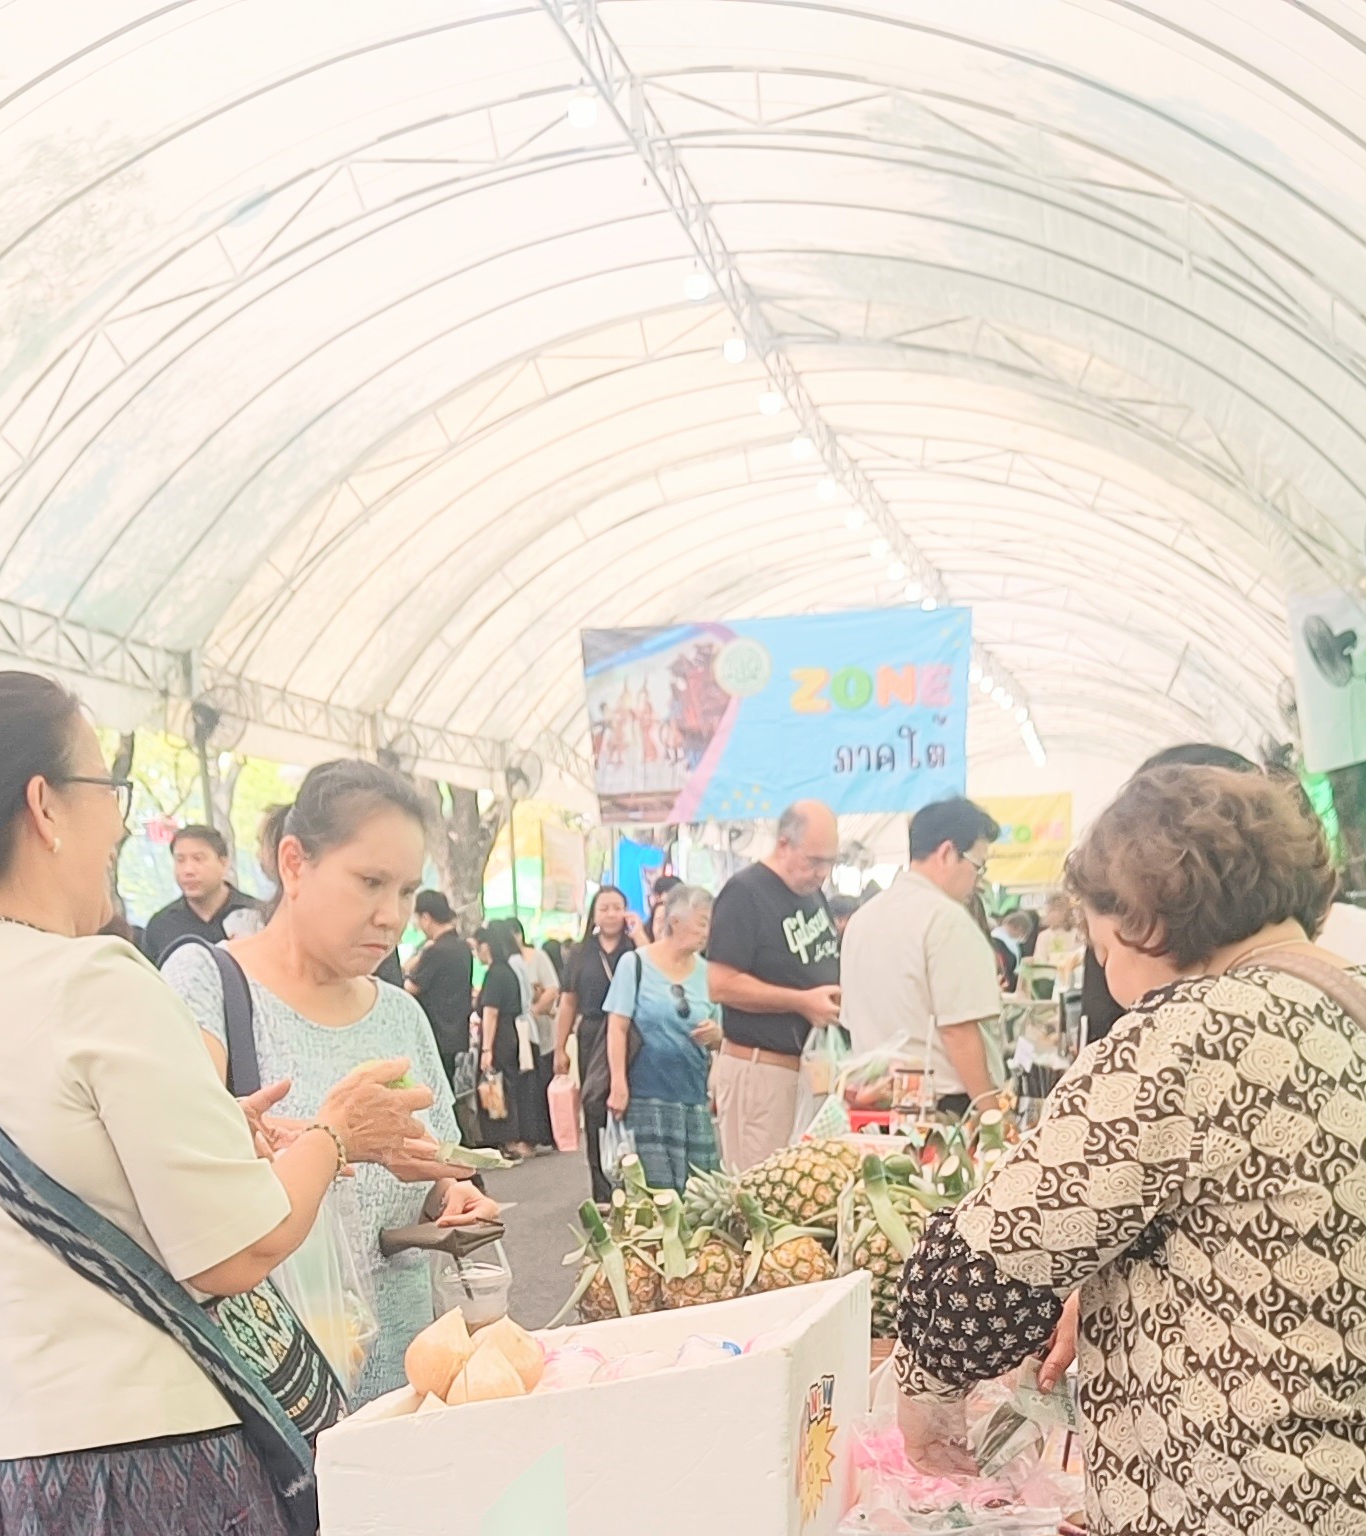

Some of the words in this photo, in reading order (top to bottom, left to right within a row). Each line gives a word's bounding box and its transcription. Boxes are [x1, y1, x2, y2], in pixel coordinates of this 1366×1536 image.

[790, 663, 951, 713] ZONE
[833, 714, 947, 773] ภาคใต้
